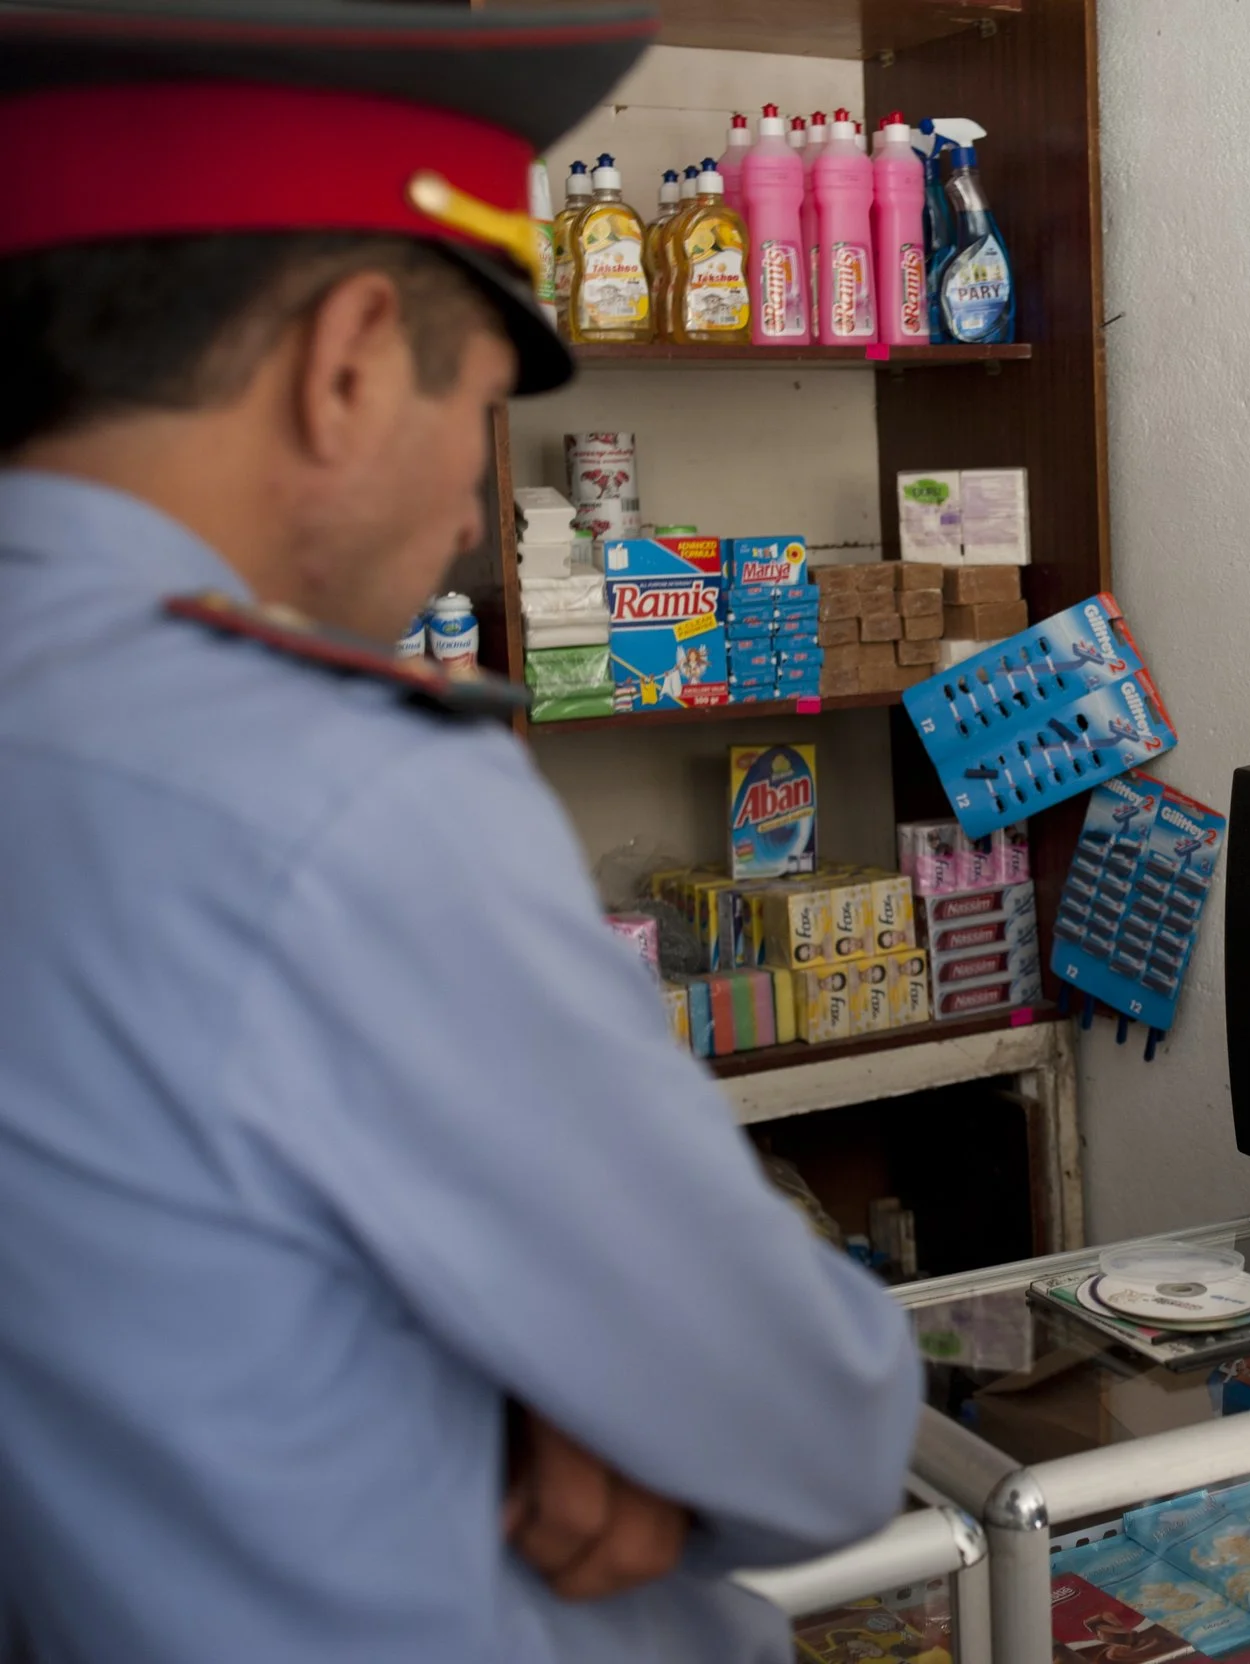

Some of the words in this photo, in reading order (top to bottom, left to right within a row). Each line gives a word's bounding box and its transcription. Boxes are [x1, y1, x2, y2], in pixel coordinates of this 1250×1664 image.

[903, 251, 922, 332] Ramis
[958, 283, 1001, 301] PARY
[742, 562, 791, 582] Mariya
[613, 582, 717, 621] Ramis
[1109, 659, 1127, 675] 2
[921, 718, 935, 734] 12
[1144, 737, 1162, 752] 2
[734, 777, 811, 827] Aban
[956, 793, 970, 808] 12
[1142, 794, 1155, 812] 2
[1204, 828, 1217, 845] 2
[947, 898, 991, 915] Nassim
[950, 927, 994, 944] Nassim
[953, 958, 997, 974] Nassim
[1066, 964, 1079, 979] 12
[1130, 999, 1143, 1014] 12
